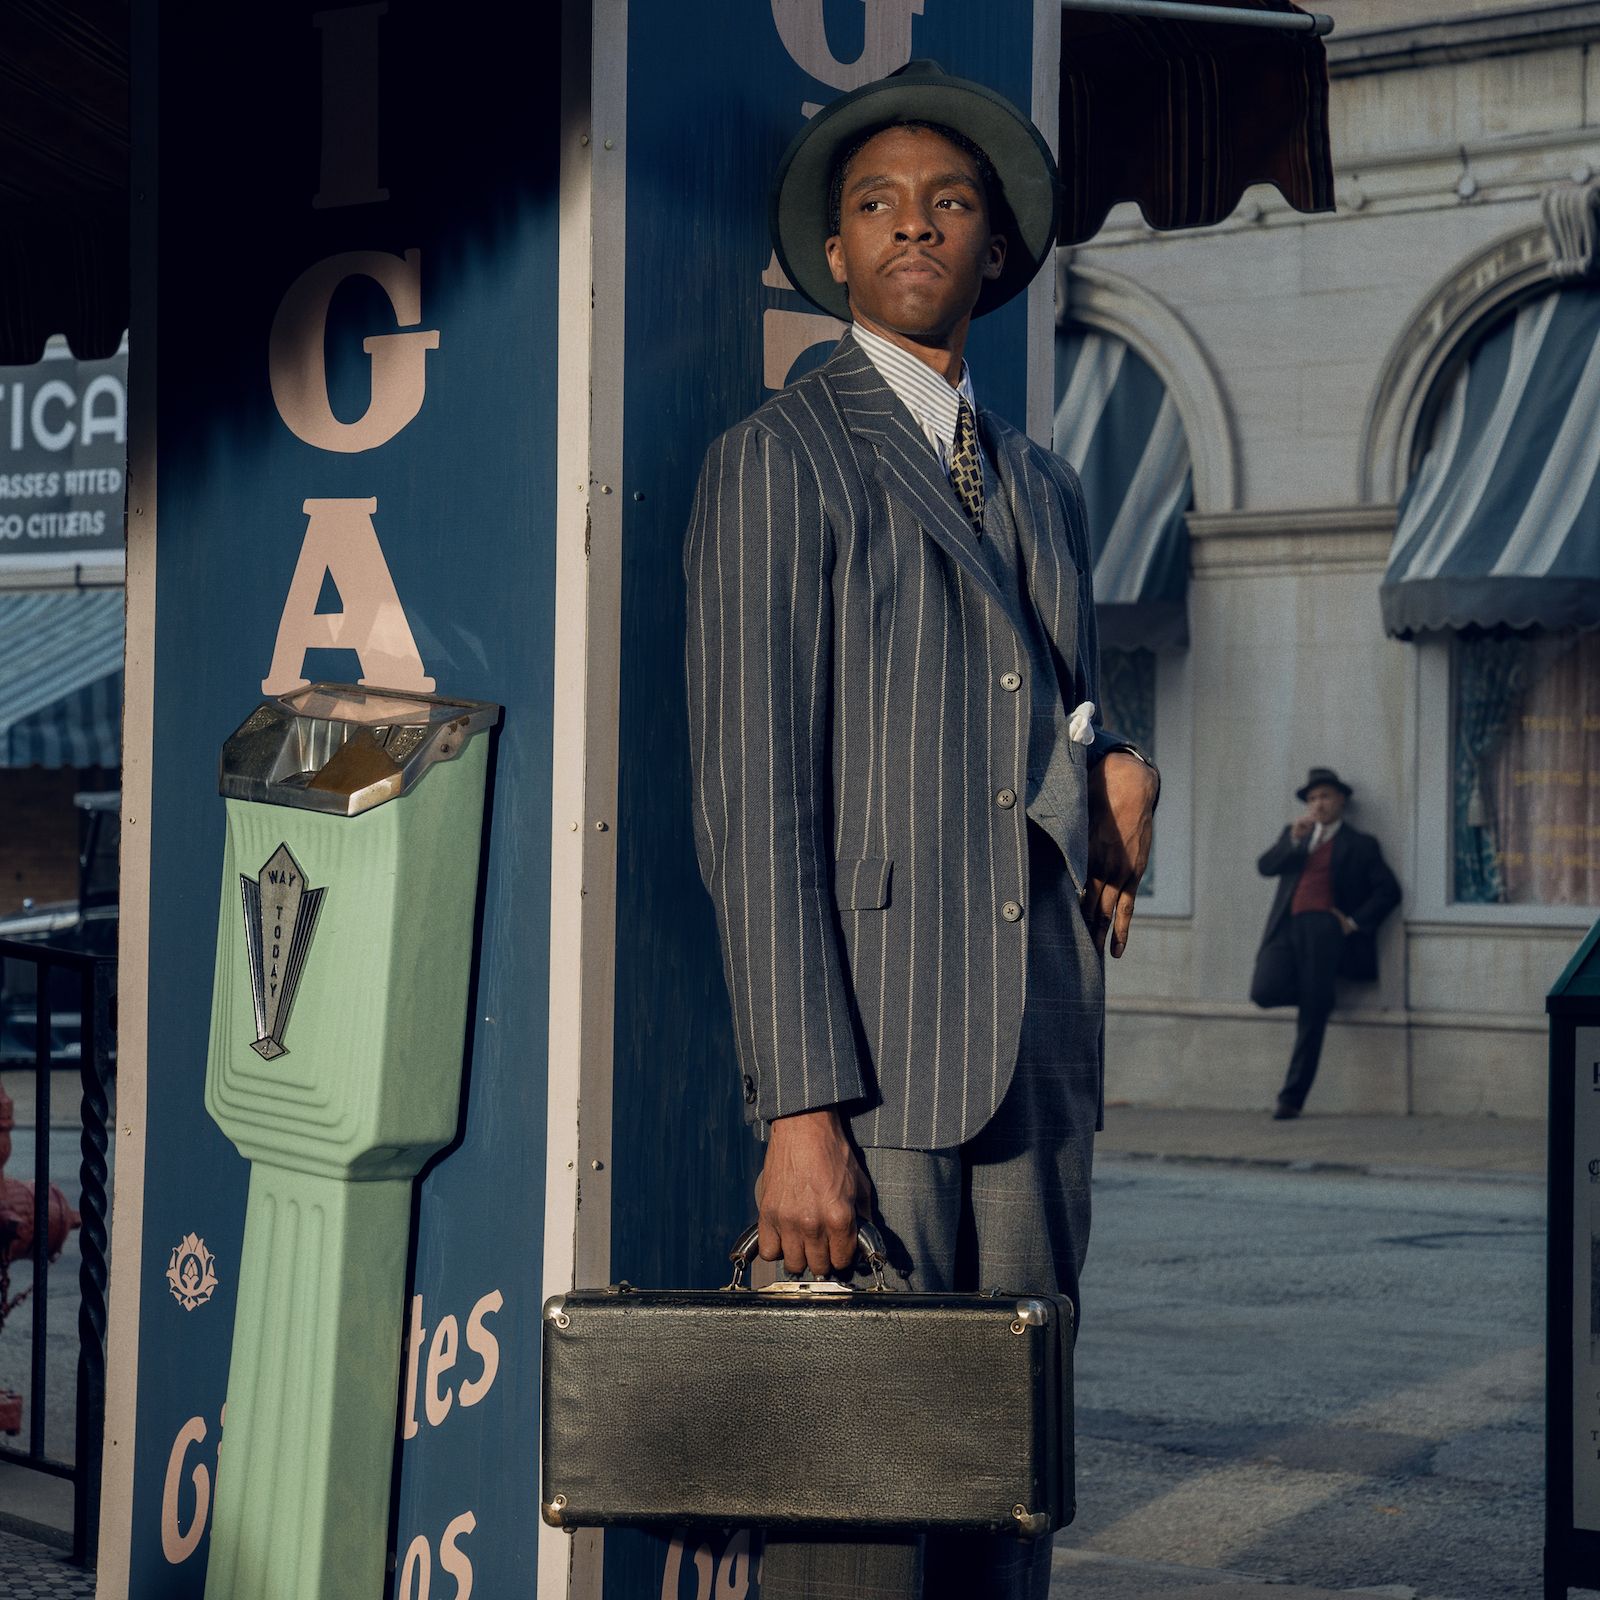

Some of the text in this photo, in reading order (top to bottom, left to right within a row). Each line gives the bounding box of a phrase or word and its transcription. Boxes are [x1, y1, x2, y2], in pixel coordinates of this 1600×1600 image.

[0, 374, 126, 451] ICA
[268, 870, 297, 888] WAY
[270, 906, 283, 998] TODAY
